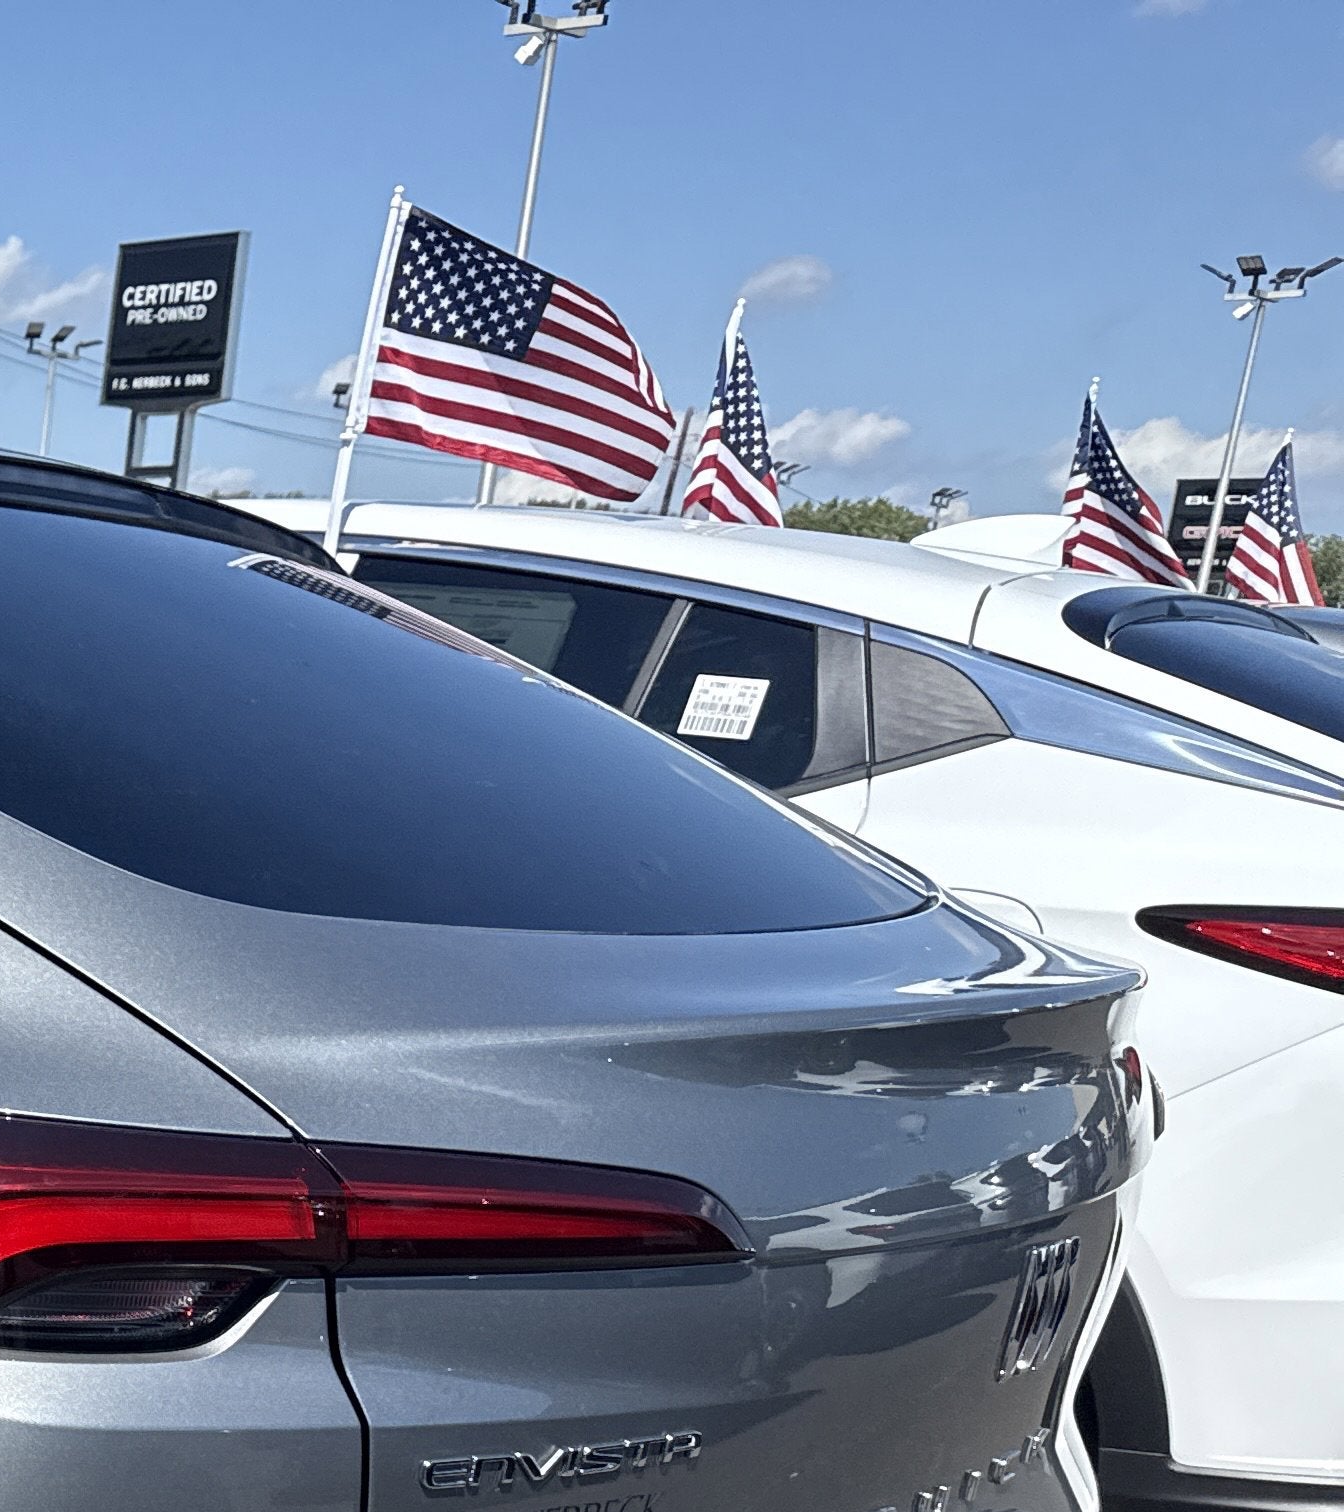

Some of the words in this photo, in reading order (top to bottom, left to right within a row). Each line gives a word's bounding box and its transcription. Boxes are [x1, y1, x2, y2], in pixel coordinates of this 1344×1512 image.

[122, 279, 218, 308] CERTIFIED
[126, 304, 208, 326] PRE-OWNED
[1185, 494, 1257, 506] BUCK
[419, 1430, 703, 1490] ENVISTA
